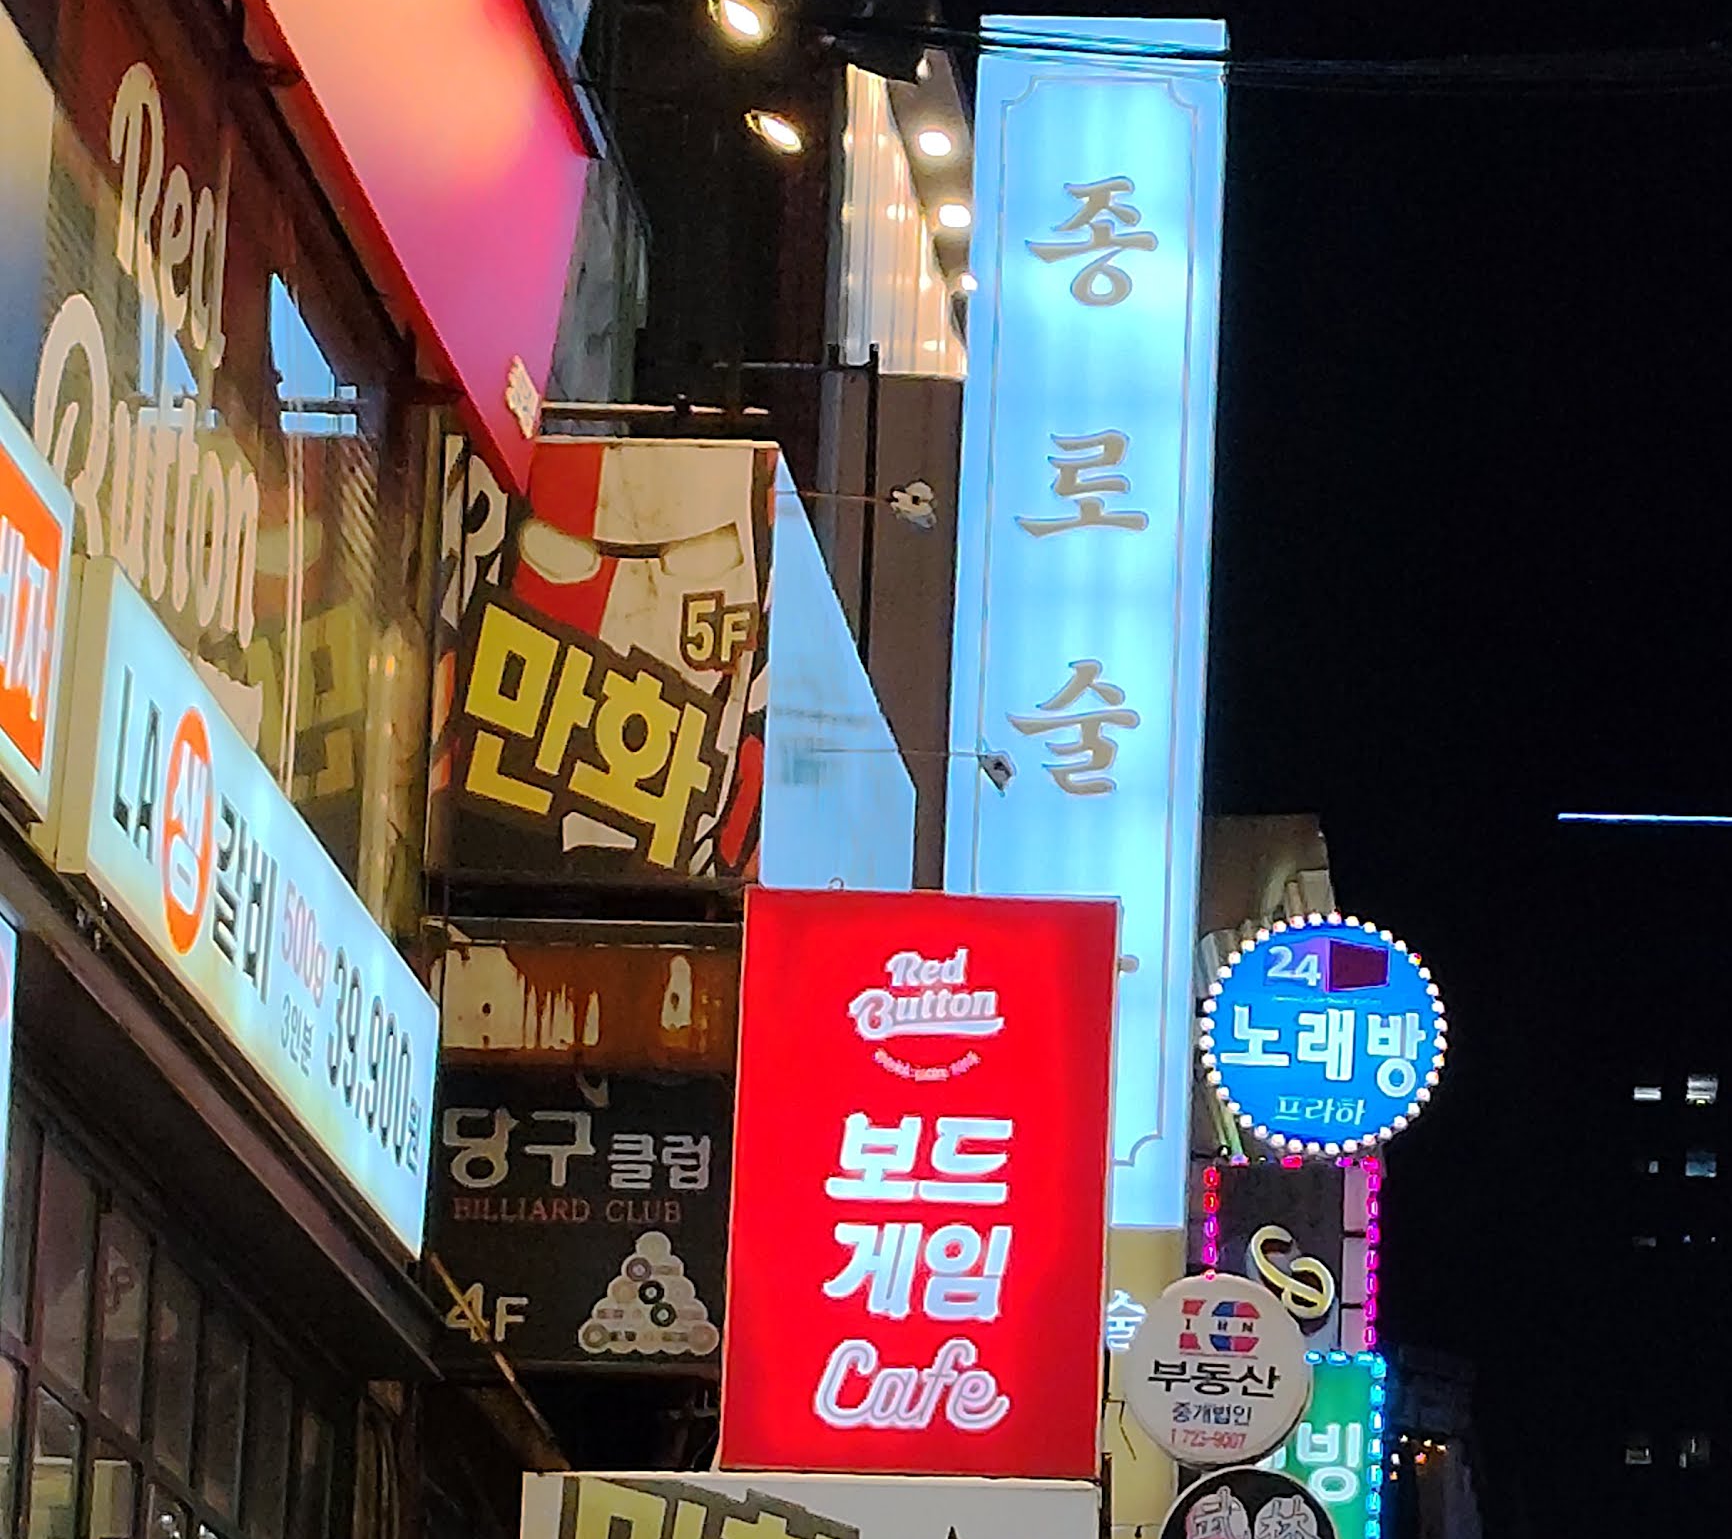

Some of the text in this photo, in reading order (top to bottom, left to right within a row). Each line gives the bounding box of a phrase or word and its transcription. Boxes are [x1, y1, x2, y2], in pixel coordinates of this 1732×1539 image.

[110, 62, 230, 370] Red
[34, 293, 260, 650] Button
[683, 598, 757, 665] 5F
[464, 600, 712, 870] 만화
[281, 879, 329, 1009] 500g
[885, 947, 967, 987] Red
[1266, 945, 1322, 988] 24
[849, 988, 1006, 1041] Button
[1221, 1004, 1427, 1098] 노래방
[1275, 1096, 1367, 1126] 프라하
[824, 1111, 1014, 1205] 보드
[452, 1197, 684, 1225] BILLIARD CLUB
[822, 1222, 1014, 1321] 게임
[445, 1282, 529, 1342] 4F
[814, 1338, 1011, 1431] Cafe
[1147, 1359, 1282, 1399] 부동산
